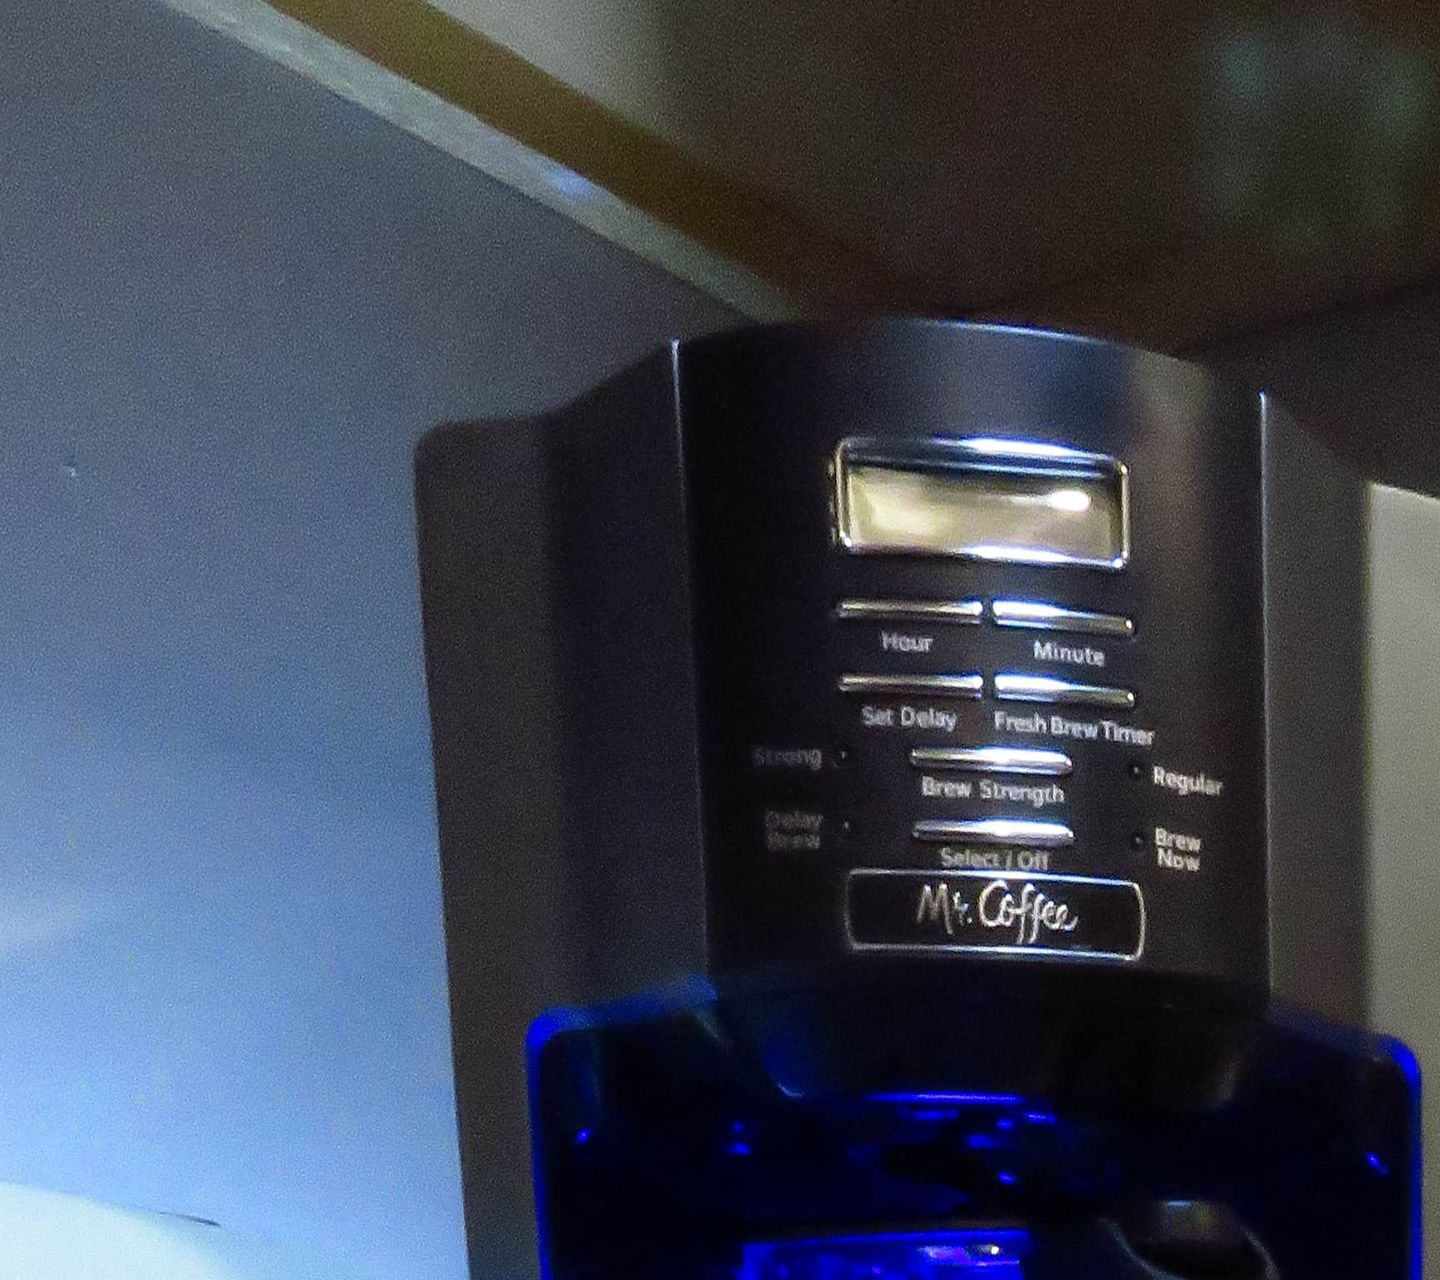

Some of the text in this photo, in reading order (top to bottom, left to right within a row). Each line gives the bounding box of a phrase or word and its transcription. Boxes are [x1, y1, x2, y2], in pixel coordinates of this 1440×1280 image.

[881, 631, 933, 653] Hour
[1033, 640, 1105, 667] Minute
[862, 705, 957, 731] Set Delay
[994, 709, 1156, 746] Fresh Brew Timer
[921, 775, 1065, 808] Brew Strength
[1152, 765, 1223, 796] Regular
[1155, 827, 1200, 850] Brew
[1157, 849, 1200, 872] Now
[916, 879, 1079, 945] Mr. Coffee
